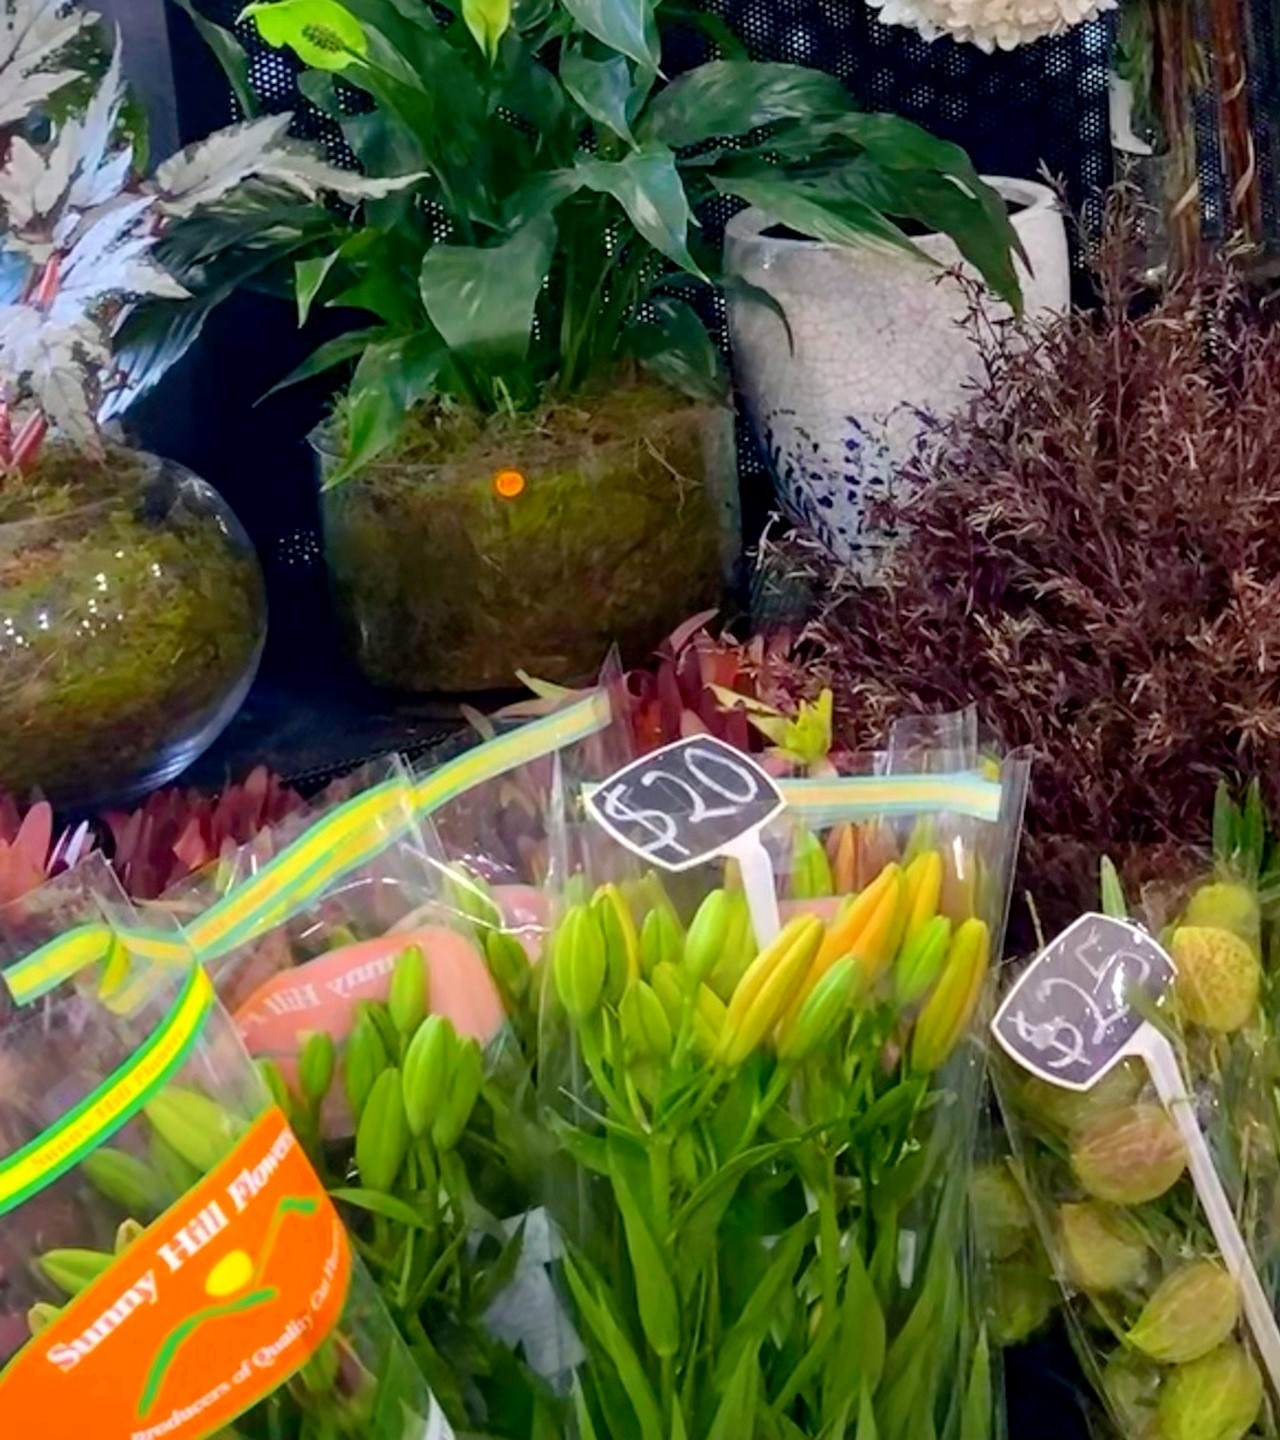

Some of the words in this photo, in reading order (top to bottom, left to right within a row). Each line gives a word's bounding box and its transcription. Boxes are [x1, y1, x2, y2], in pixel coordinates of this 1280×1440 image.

[602, 747, 758, 856] $20
[1005, 925, 1150, 1069] $25
[46, 1268, 157, 1372] Sunny
[157, 1200, 229, 1273] Hill
[232, 1358, 253, 1384] of
[252, 1312, 313, 1368] Quality
